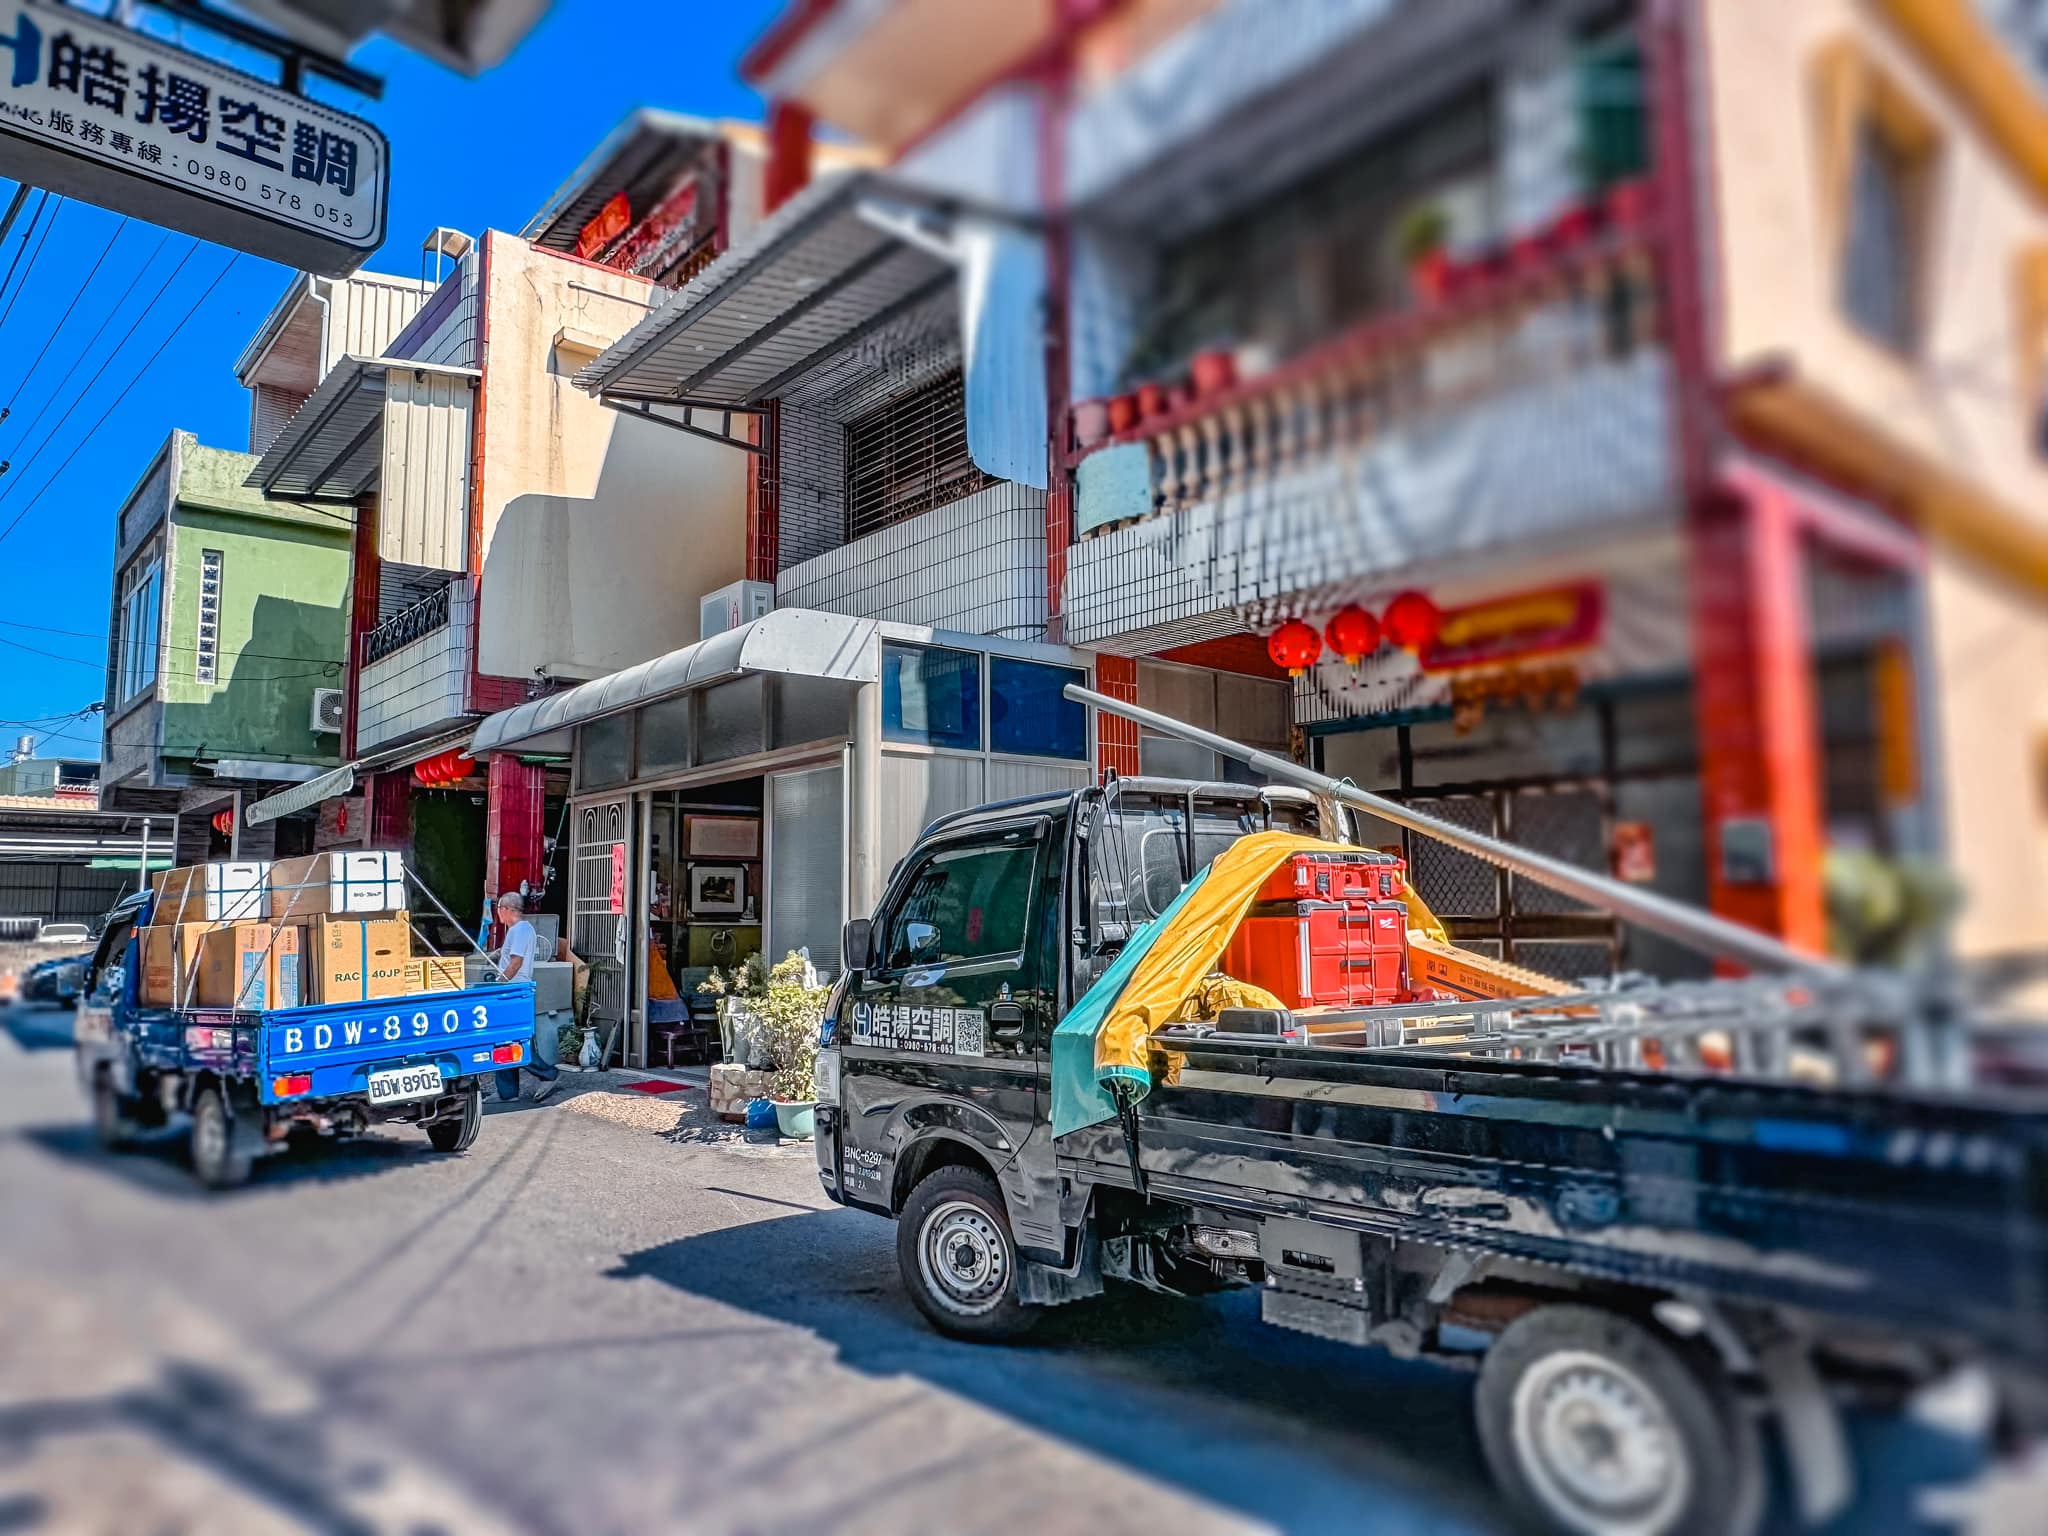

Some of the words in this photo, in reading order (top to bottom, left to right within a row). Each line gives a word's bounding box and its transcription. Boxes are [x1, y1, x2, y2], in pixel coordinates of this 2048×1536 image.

[260, 184, 301, 210] 578
[314, 203, 353, 228] 053
[285, 1005, 489, 1053] BDW-8903
[872, 1003, 954, 1044] 皓揚空調
[370, 1071, 441, 1099] BDW-8903
[844, 1146, 882, 1166] BNC-6297
